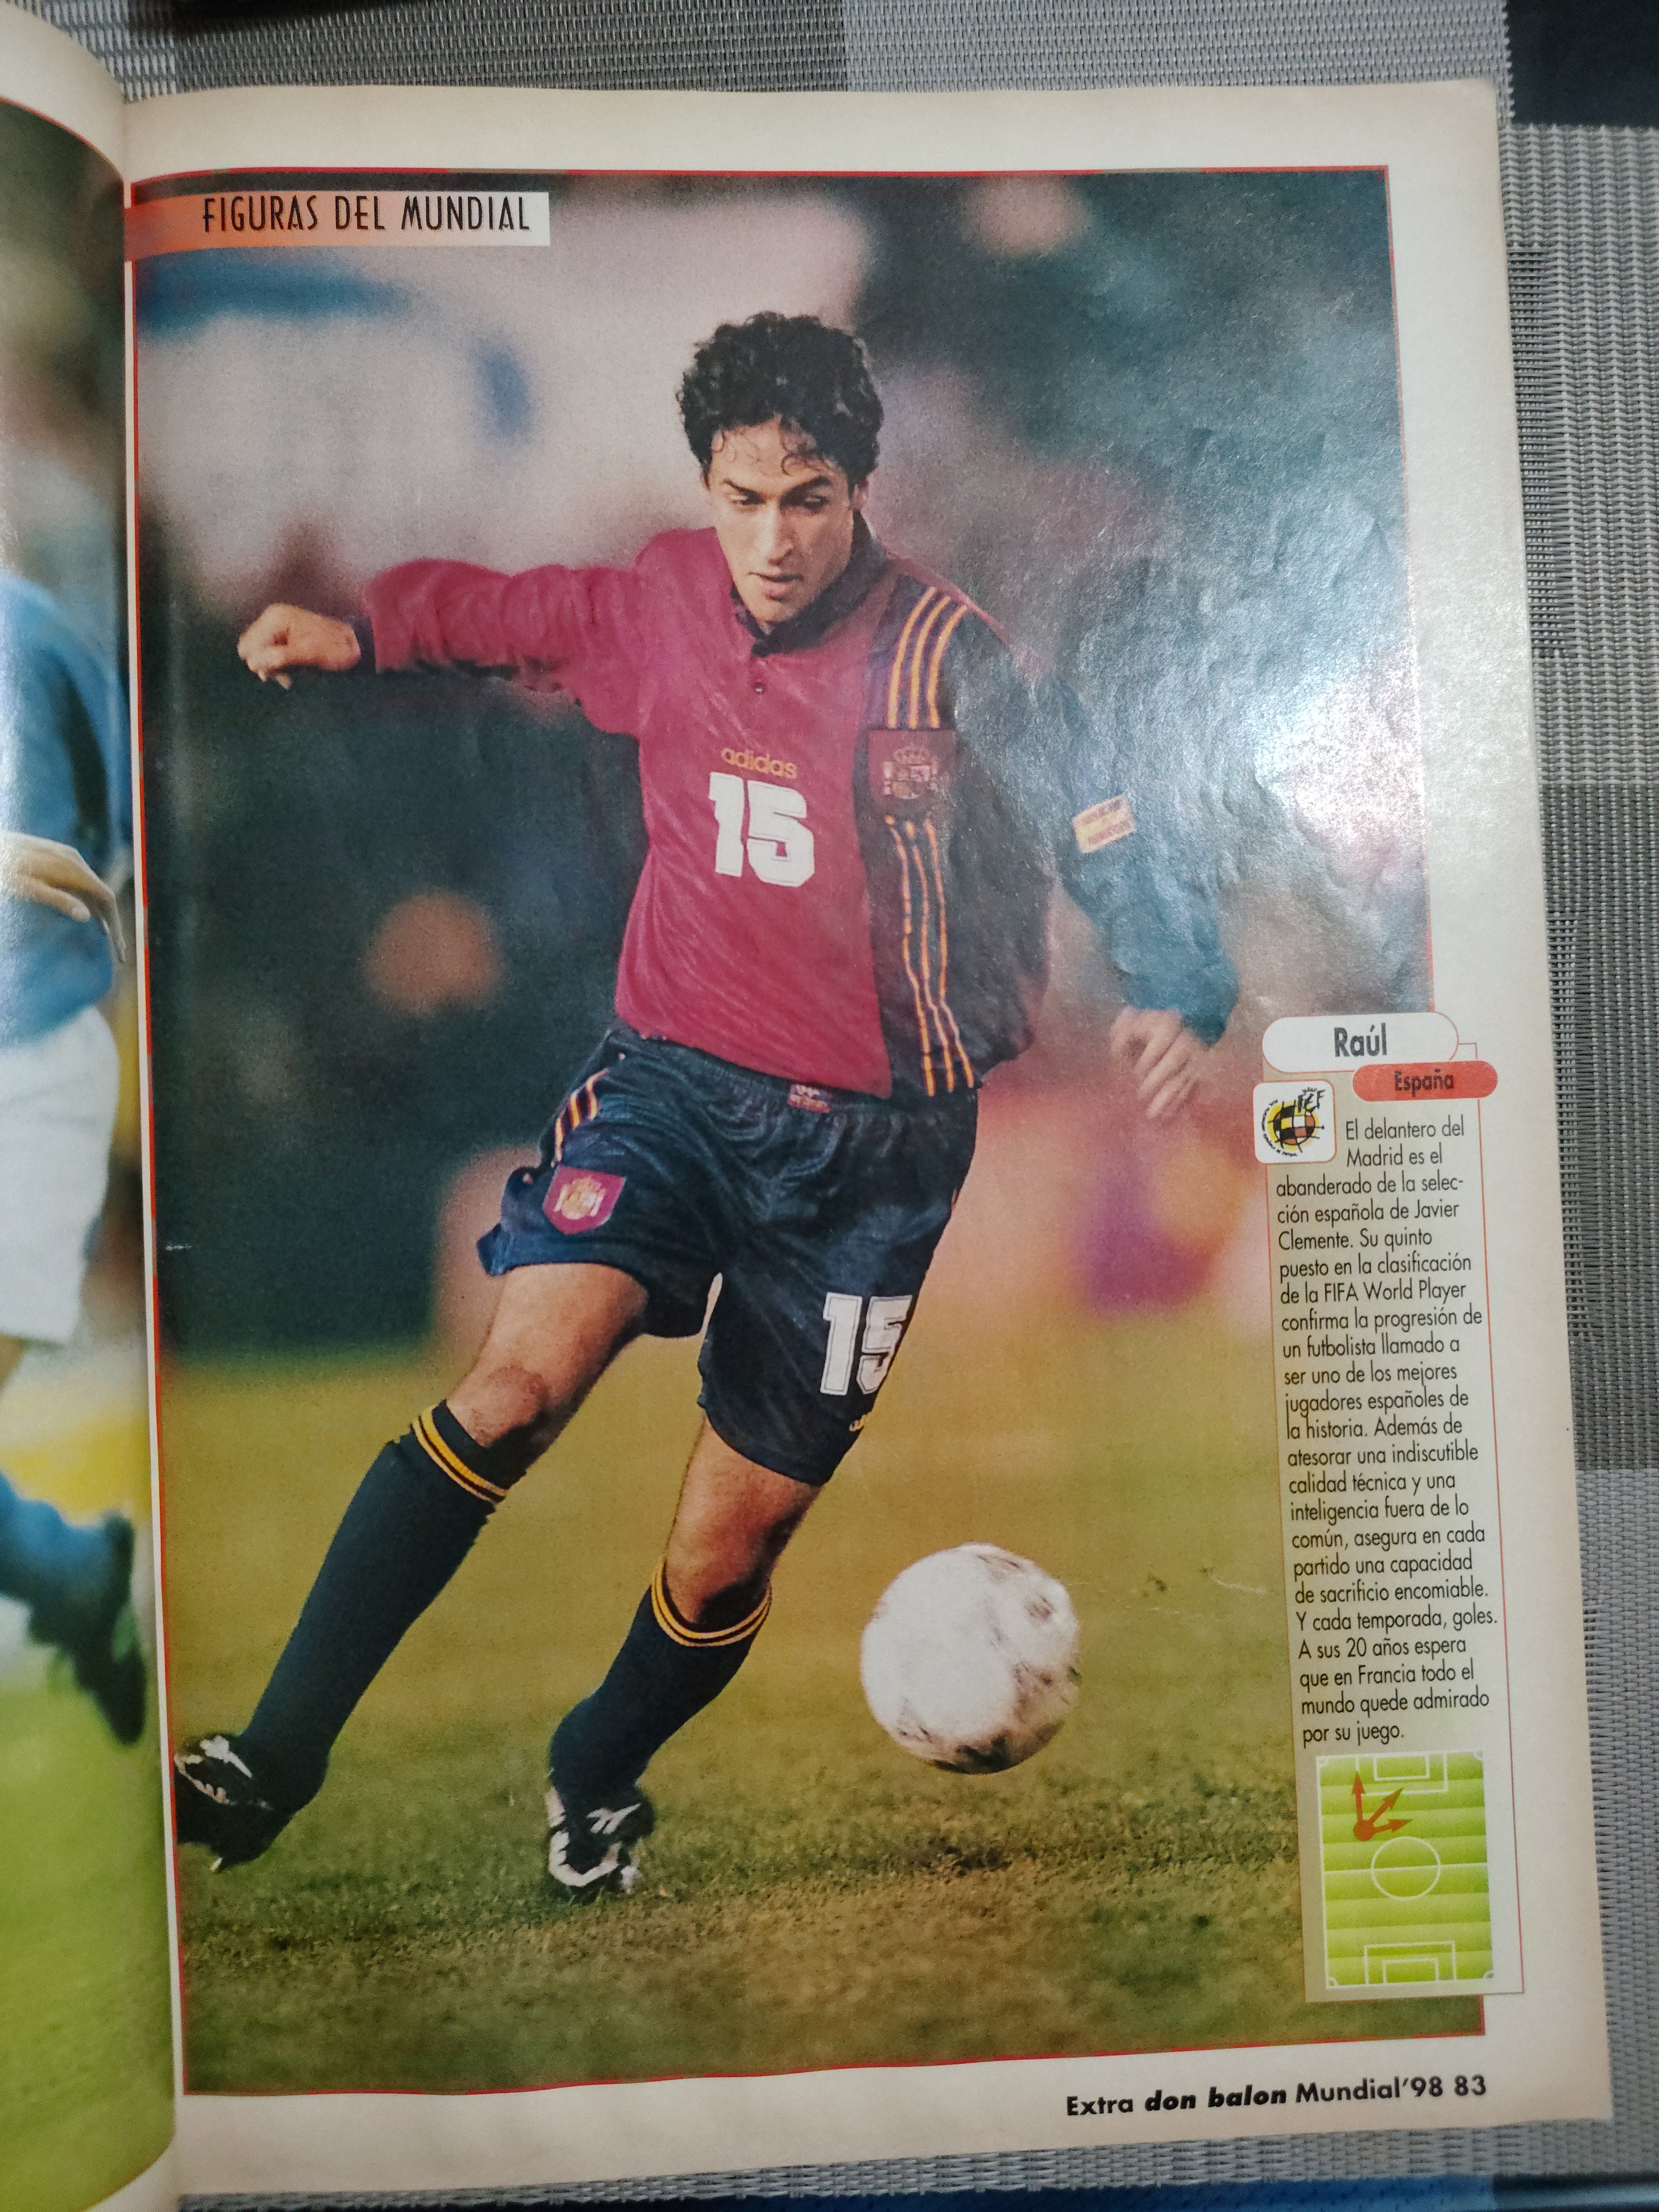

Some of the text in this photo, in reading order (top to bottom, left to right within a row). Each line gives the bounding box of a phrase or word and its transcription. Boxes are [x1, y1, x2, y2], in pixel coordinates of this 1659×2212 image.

[202, 194, 531, 233] FIGURAS DEL MUNDIAL
[721, 747, 797, 779] adidas
[709, 771, 814, 887] 15
[1333, 1022, 1387, 1057] Raúl
[1394, 1068, 1454, 1097] España
[1345, 1114, 1465, 1141] El delantero del
[1346, 1142, 1442, 1167] Madrid es el
[1276, 1169, 1464, 1197] abanderado de la selec-
[1277, 1197, 1460, 1228] ción española de Javier
[1278, 1228, 1433, 1253] Clemente. Su quinto
[1279, 1250, 1472, 1284] puesto en la clasificación
[1280, 1277, 1467, 1305] de la FIFA World Player
[1281, 1302, 1482, 1334] confirma la progresión de
[820, 1292, 913, 1396] 15
[1283, 1330, 1460, 1359] un futbolista llamado a
[1284, 1359, 1458, 1387] ser uno de los mejores
[1285, 1384, 1469, 1417] jugadores españoles de
[1285, 1411, 1462, 1440] la historia. Además de
[1287, 1438, 1479, 1467] atesorar una indiscutible
[1289, 1469, 1455, 1496] calidad técnica y una
[1290, 1493, 1469, 1526] inteligencia fuera de lo
[1291, 1520, 1485, 1552] común, asegura en cada
[1293, 1547, 1473, 1582] partido una capacidad
[1294, 1574, 1488, 1604] de sacrificio encomiable.
[1296, 1602, 1498, 1635] Y cada temporada, goles.
[1298, 1636, 1466, 1660] A sus 20 años espera
[1299, 1657, 1474, 1694] que en Francia todo el
[1301, 1684, 1490, 1718] mundo quede admirado
[1303, 1720, 1404, 1749] por su juego.
[1066, 2095, 1134, 2116] Extra
[1144, 2089, 1197, 2112] don
[1207, 2083, 1287, 2108] balon
[1454, 2074, 1487, 2097] 83
